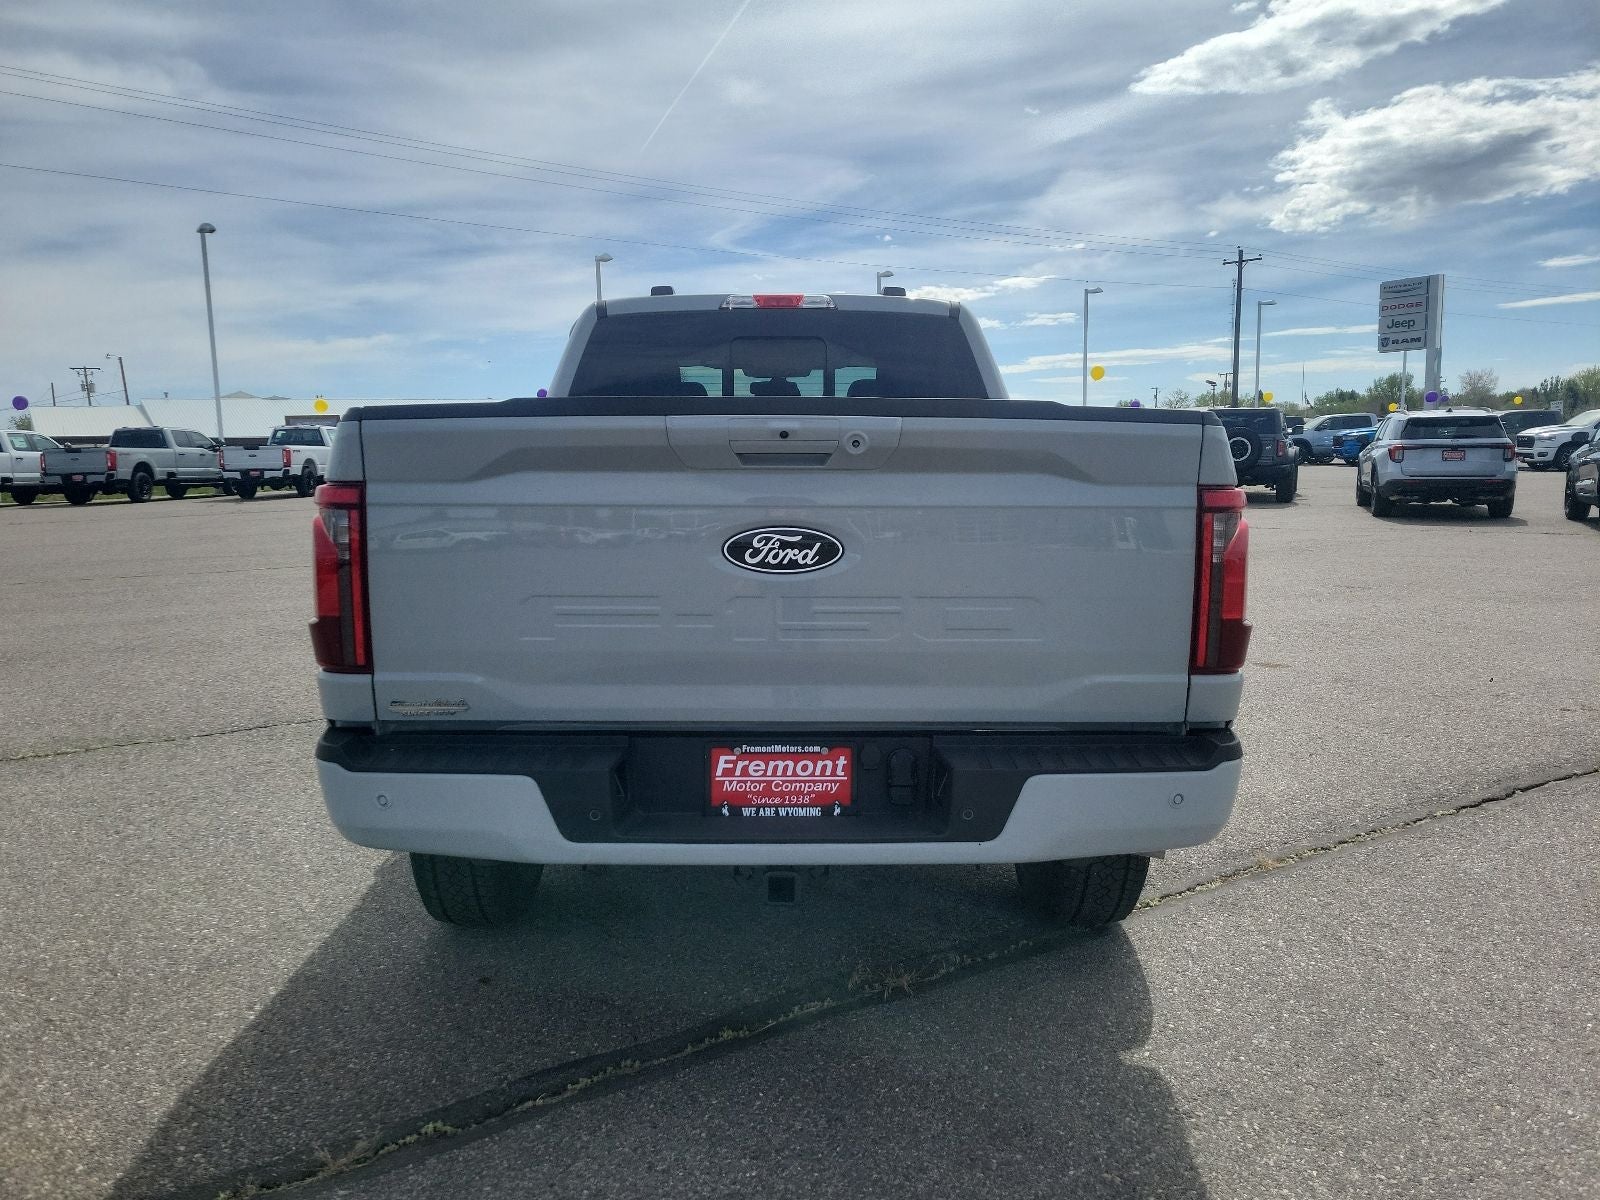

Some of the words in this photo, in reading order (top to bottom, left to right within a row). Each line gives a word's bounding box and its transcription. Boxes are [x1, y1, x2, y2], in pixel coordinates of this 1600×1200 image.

[1381, 301, 1423, 311] DODGE
[1387, 319, 1415, 329] Jeep
[1391, 337, 1422, 345] RAM
[744, 533, 821, 564] Ford
[518, 594, 1043, 642] F-150
[742, 744, 821, 753] FremontMotors.com
[715, 755, 847, 776] Fremont
[723, 780, 766, 791] Motor
[771, 780, 839, 793] Company
[742, 807, 757, 817] WE
[758, 807, 776, 817] ARE
[778, 807, 821, 817] WYOMING
